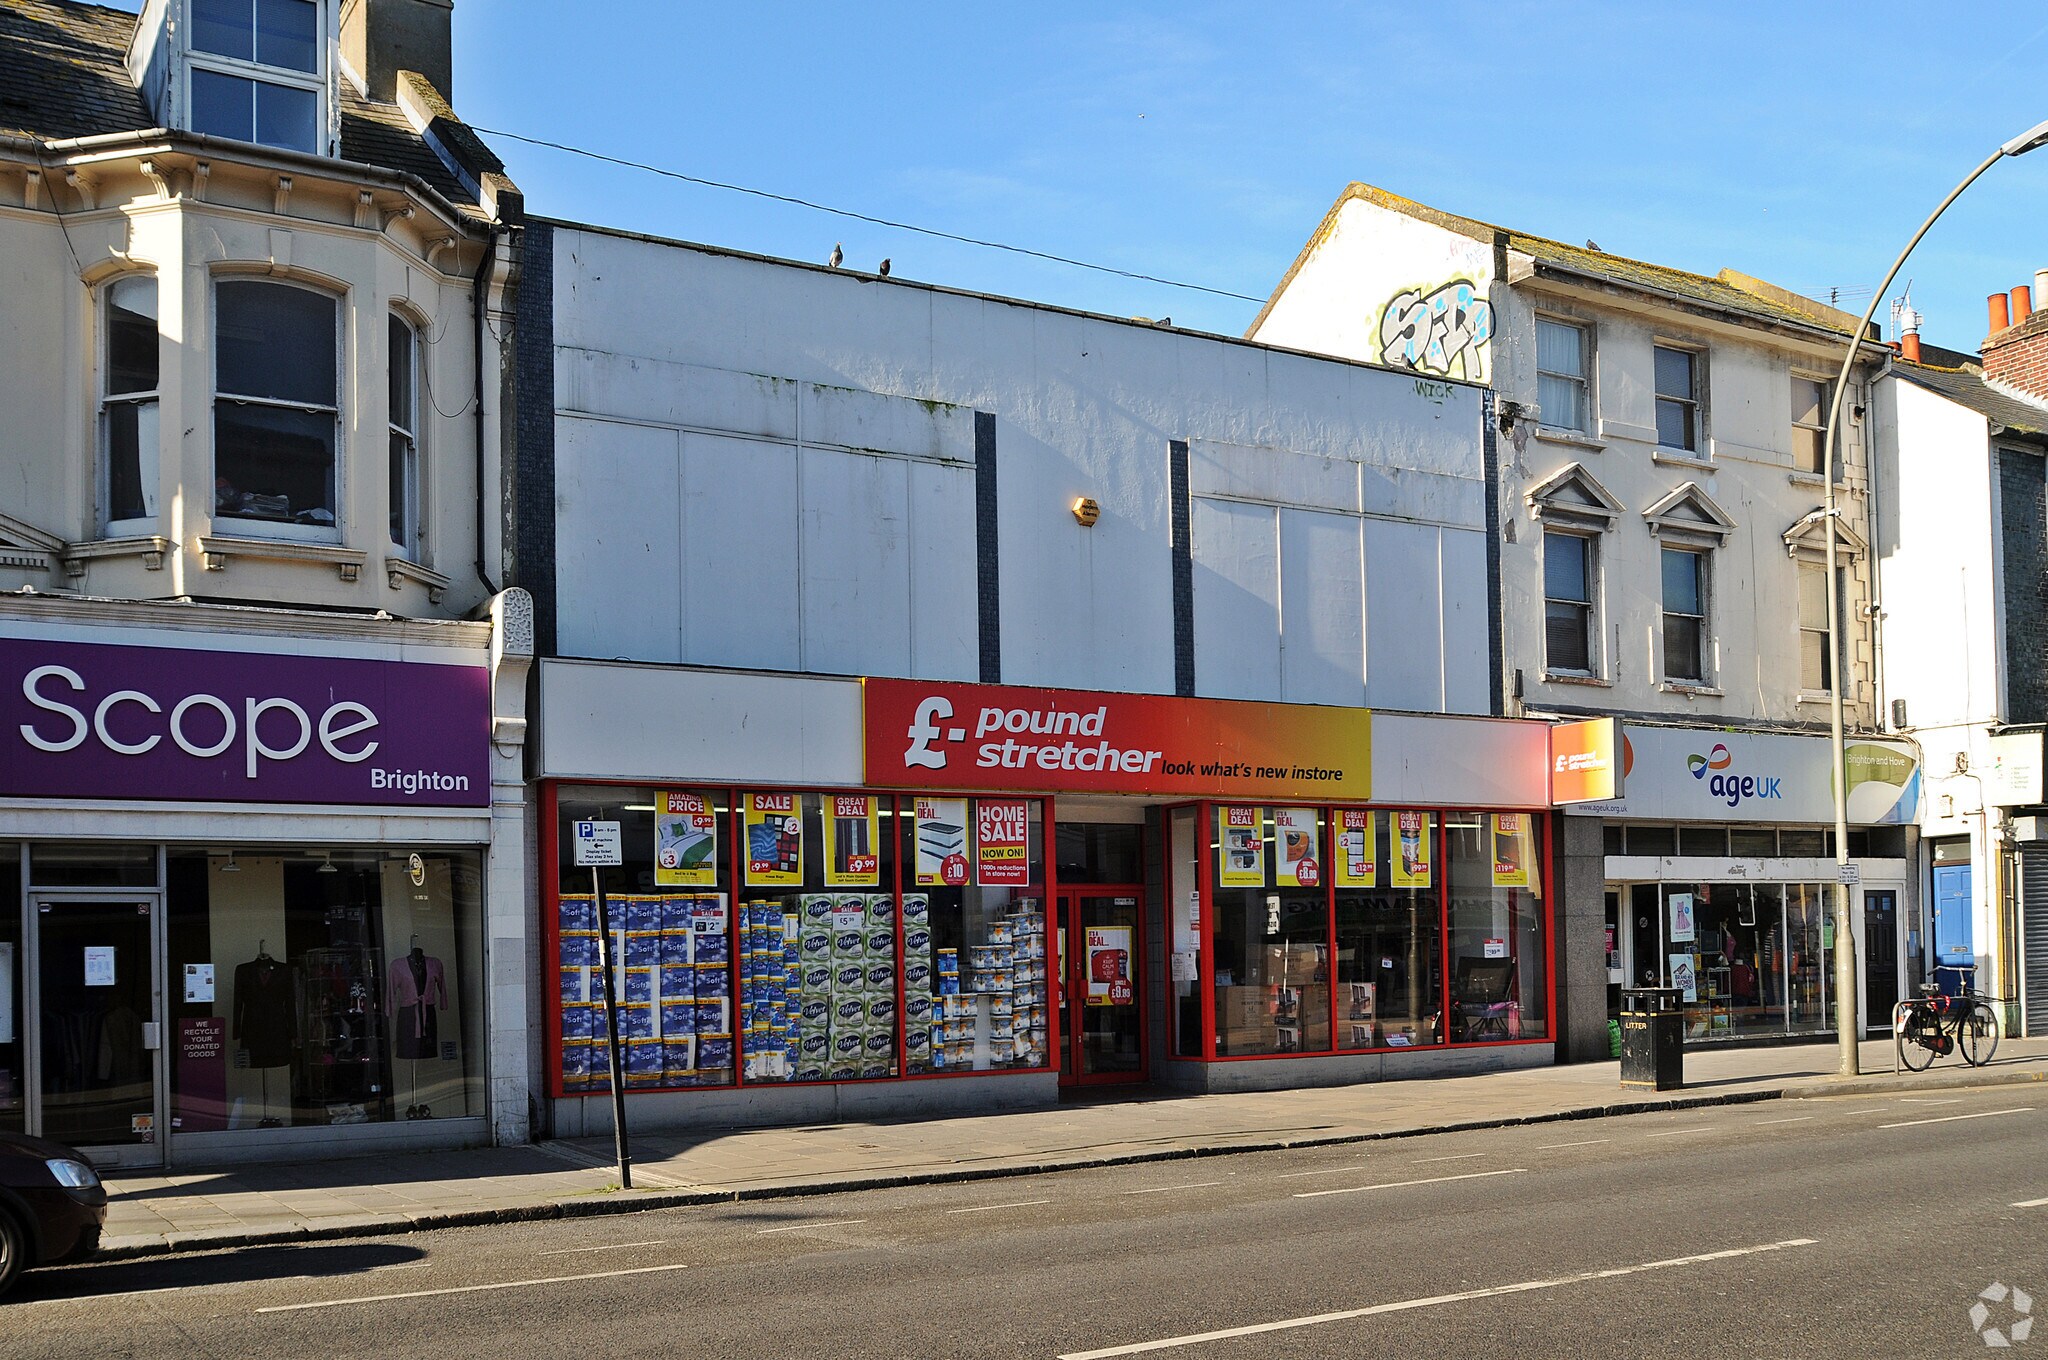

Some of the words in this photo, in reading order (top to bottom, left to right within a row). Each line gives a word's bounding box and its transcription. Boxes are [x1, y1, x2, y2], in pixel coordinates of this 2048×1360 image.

[1415, 380, 1455, 399] WICK
[20, 664, 379, 778] Scope
[974, 706, 1107, 739] pound
[976, 738, 1162, 773] stretcher
[1848, 754, 1875, 766] Brighton
[1875, 756, 1889, 766] and
[1890, 757, 1905, 766] Hove
[1161, 760, 1195, 776] look
[1200, 761, 1251, 778] what's
[1255, 766, 1288, 779] new
[1291, 765, 1343, 781] instore
[371, 768, 469, 796] Brighton
[668, 800, 704, 812] PRICE
[756, 796, 790, 810] SALE
[837, 798, 865, 806] GREAT
[838, 806, 865, 815] DEAL
[1230, 808, 1253, 816] GREAT
[1578, 804, 1628, 814] www.ageuk.org.uk
[979, 806, 1024, 822] HOME
[1400, 813, 1420, 821] GREAT
[1231, 816, 1252, 825] DEAL
[1346, 819, 1365, 827] DEAL
[1401, 820, 1420, 829] DEAL
[1501, 822, 1519, 830] DEAL
[980, 822, 1025, 842] SALE
[982, 849, 1005, 858] NOW
[1007, 848, 1024, 857] ON!
[950, 856, 954, 864] 3
[751, 862, 769, 872] £9.99
[849, 860, 874, 872] £9.99
[947, 864, 964, 878] £10
[810, 904, 831, 913] Velvet
[874, 904, 893, 914] Velvet
[905, 904, 927, 913] Velvet
[805, 938, 829, 947] Velvet
[838, 937, 860, 946] Velvet
[871, 937, 892, 946] Velvet
[909, 936, 929, 945] Velvet
[807, 972, 830, 982] Velvet
[840, 971, 862, 980] Velvet
[870, 970, 892, 980] Velvet
[907, 970, 929, 978] Velvet
[804, 1006, 827, 1015] Velvet
[839, 1004, 862, 1014] Velvet
[872, 1004, 894, 1014] Velvet
[908, 1003, 930, 1012] Velvet
[196, 1020, 208, 1028] WE
[567, 1016, 582, 1024] Soft
[1626, 1022, 1647, 1030] LITTER
[184, 1028, 220, 1036] RECYCLE
[805, 1039, 826, 1049] Velvet
[838, 1039, 860, 1048] Velvet
[868, 1038, 890, 1047] Velvet
[906, 1035, 928, 1045] Velvet
[184, 1043, 220, 1051] DONATED
[188, 1050, 216, 1058] GOODS
[641, 1052, 656, 1060] Soft
